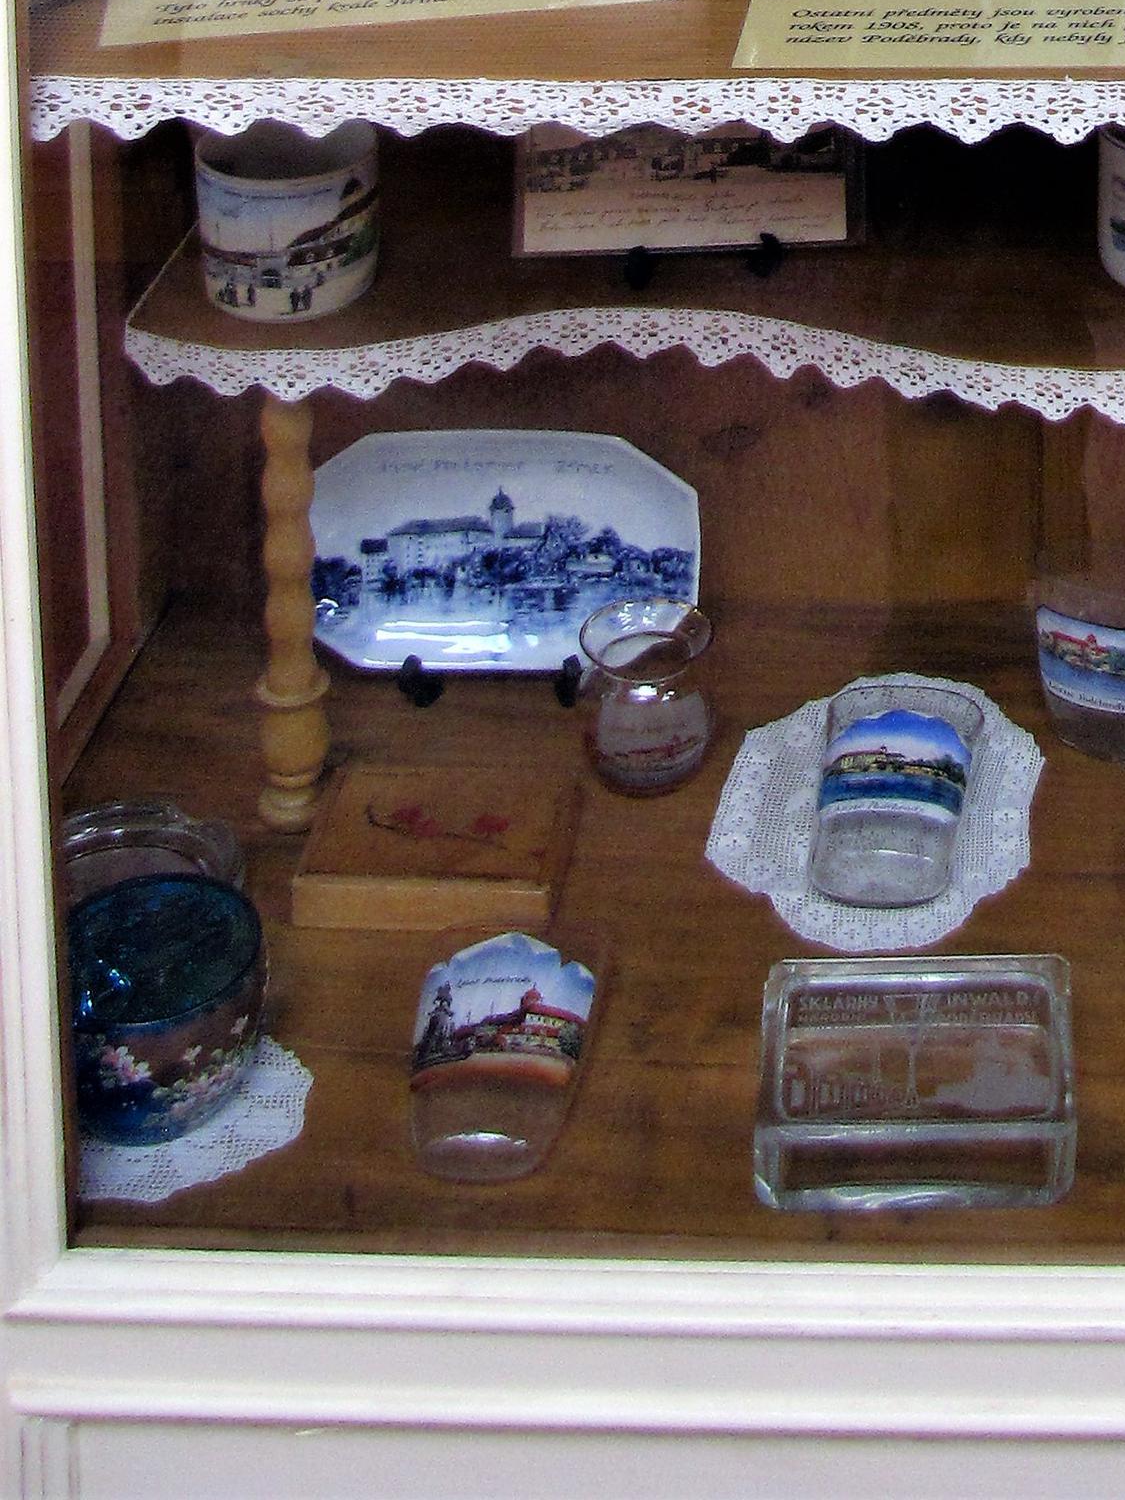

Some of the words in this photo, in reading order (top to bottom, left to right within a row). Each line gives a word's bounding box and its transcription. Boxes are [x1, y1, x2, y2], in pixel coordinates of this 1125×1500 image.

[152, 9, 249, 26] instalace
[256, 4, 317, 19] sochy
[791, 7, 875, 18] Ostatní
[881, 8, 983, 20] předměty
[990, 8, 1037, 19] jsou
[788, 20, 855, 31] rokem
[934, 21, 993, 32] proto
[998, 21, 1022, 32] je
[1031, 20, 1058, 29] na
[1067, 18, 1117, 29] nich
[784, 34, 854, 43] název
[993, 33, 1033, 45] kdy
[1042, 31, 1113, 44] nebyly
